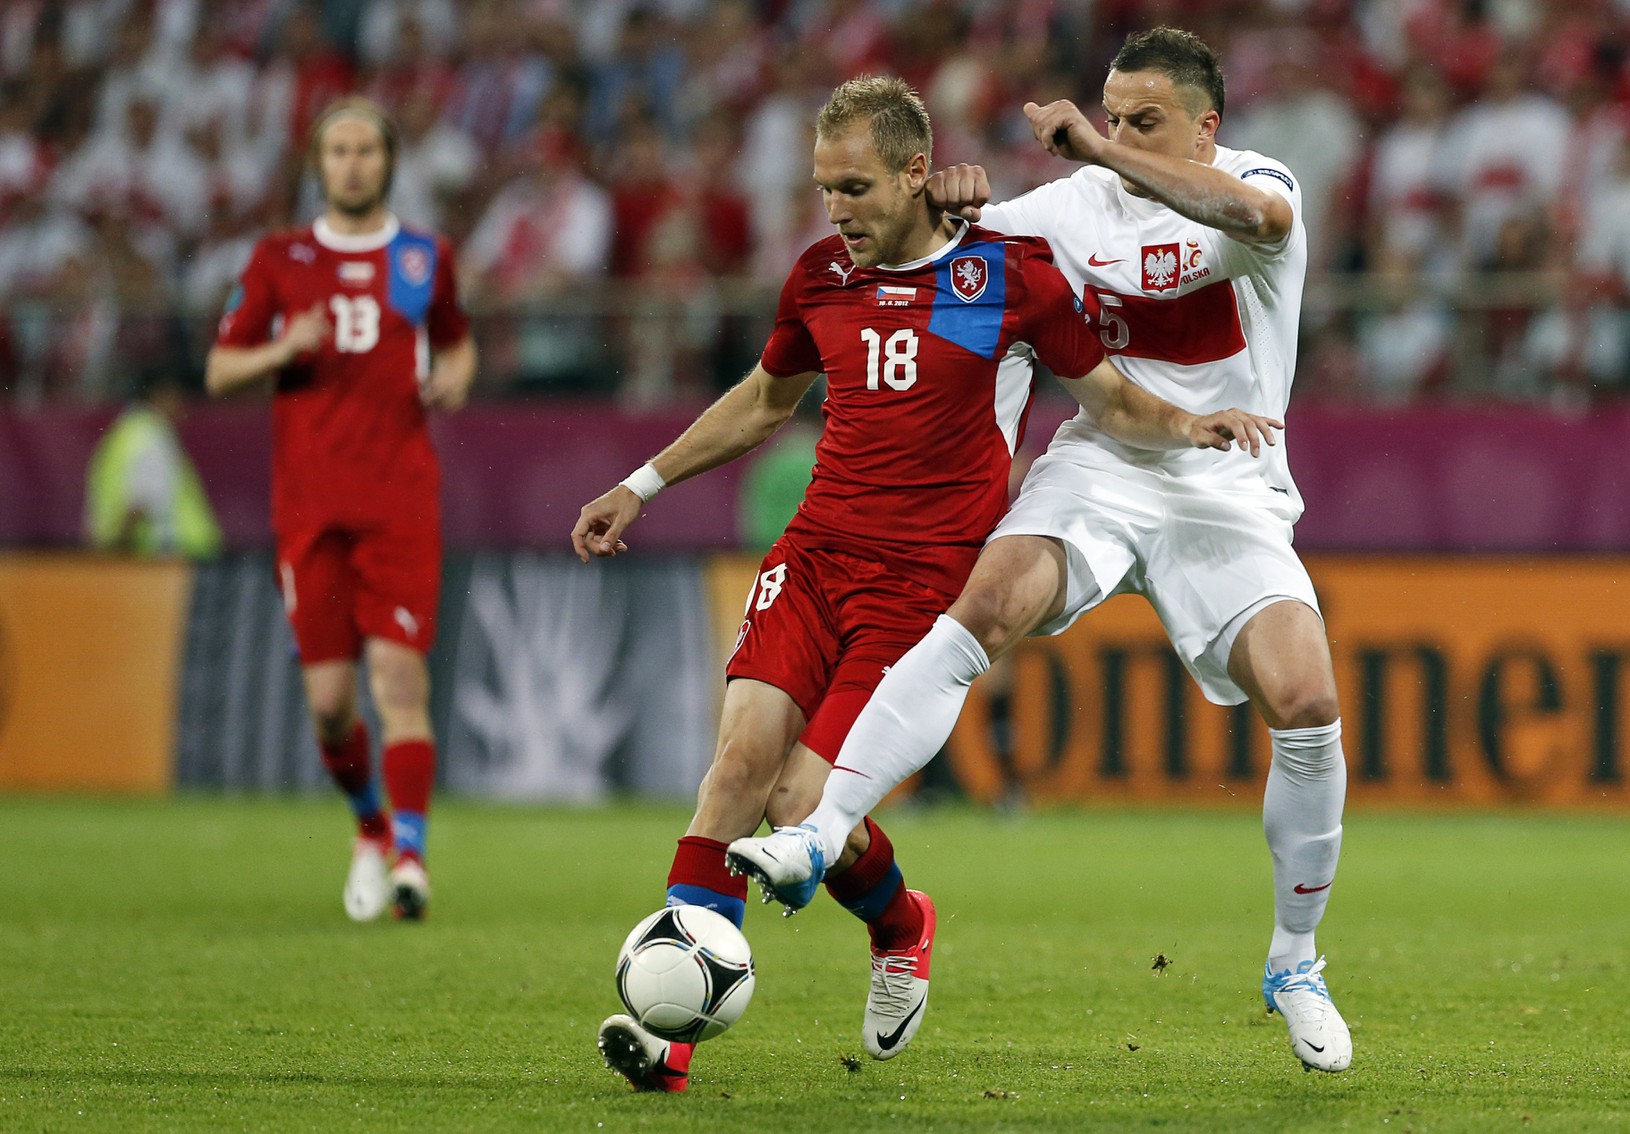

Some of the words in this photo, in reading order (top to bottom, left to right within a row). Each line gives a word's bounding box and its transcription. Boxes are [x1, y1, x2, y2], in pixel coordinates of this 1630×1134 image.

[1180, 267, 1210, 286] POLSKA
[329, 294, 381, 353] 13
[860, 327, 919, 392] 18
